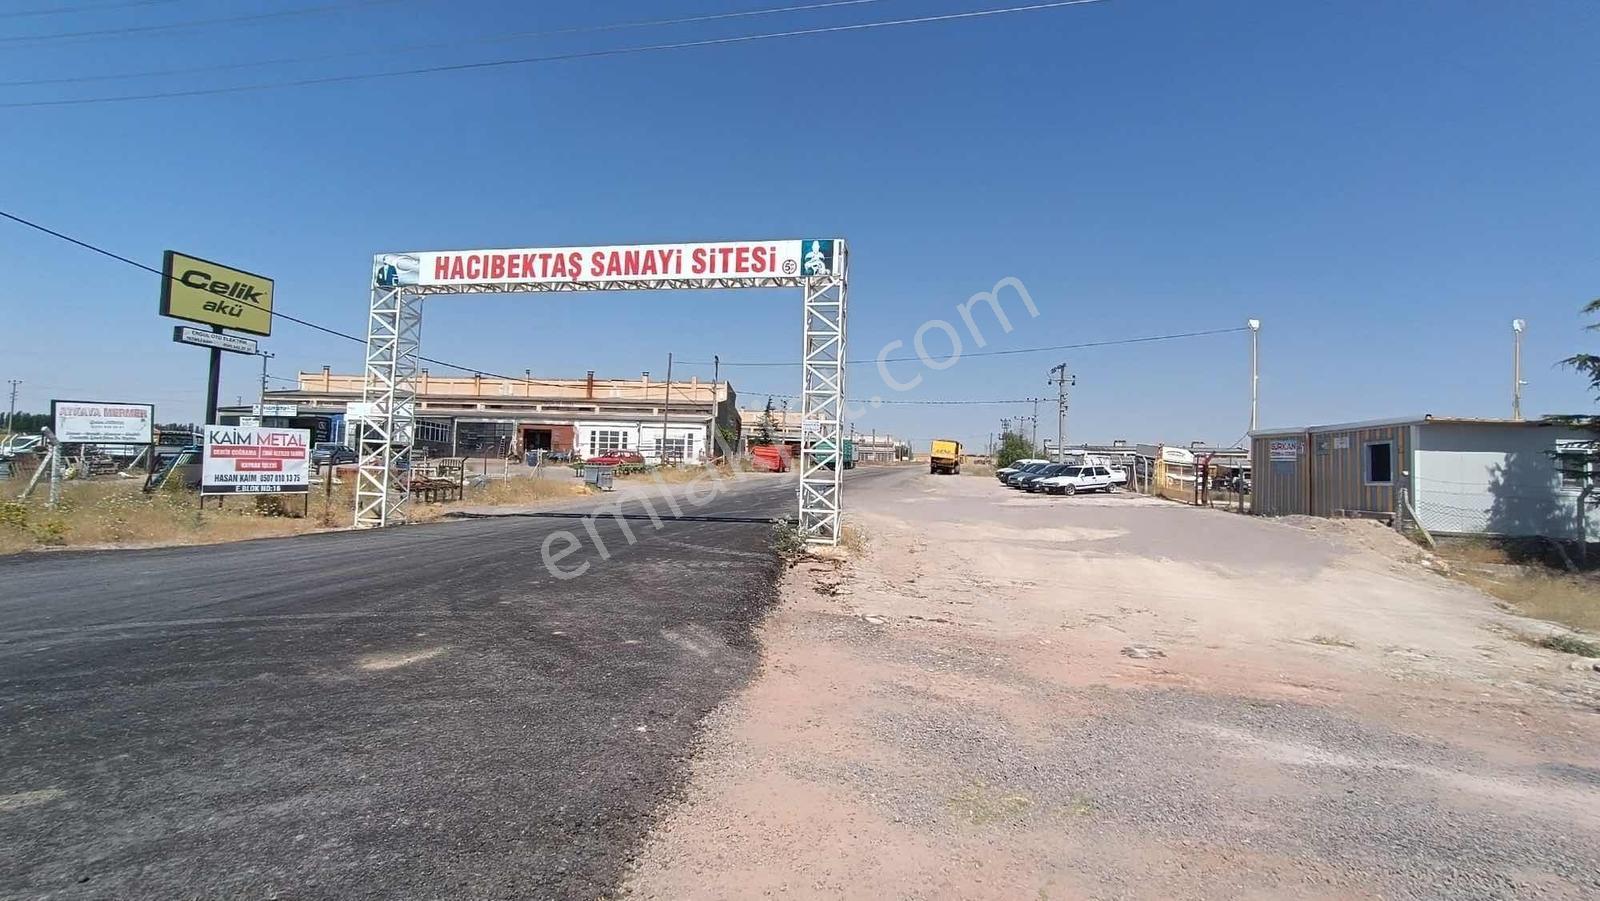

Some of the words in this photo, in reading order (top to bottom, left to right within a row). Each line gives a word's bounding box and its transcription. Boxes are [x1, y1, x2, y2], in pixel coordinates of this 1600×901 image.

[435, 252, 582, 281] HACIBEKTAŞ
[203, 301, 243, 317] akü
[209, 428, 251, 445] KAİM
[257, 433, 307, 447] METAL
[214, 474, 238, 482] HASAN
